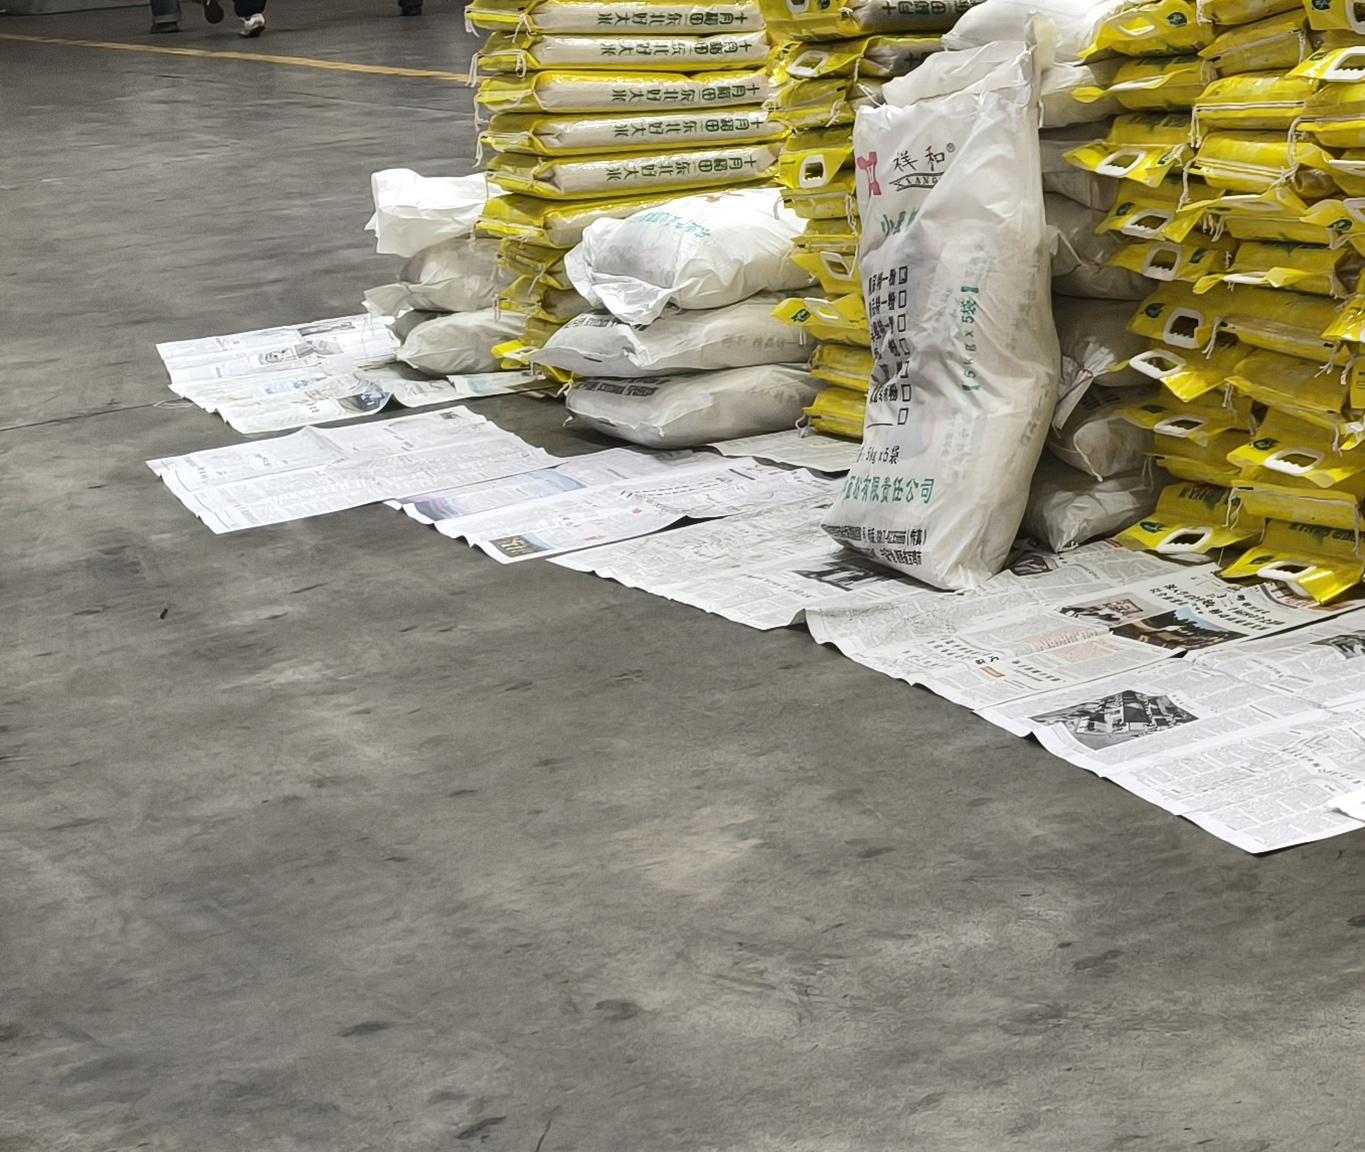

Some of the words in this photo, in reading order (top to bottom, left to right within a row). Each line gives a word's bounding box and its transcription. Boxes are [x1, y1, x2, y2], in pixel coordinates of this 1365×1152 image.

[597, 12, 682, 26] 东北好大米
[689, 12, 747, 26] 十月稻田
[600, 43, 686, 57] 东北好大米
[694, 41, 751, 55] 十月稻田
[611, 89, 695, 102] 东北好大米
[701, 85, 760, 101] 十月稻田
[614, 120, 697, 137] 东北好大米
[704, 118, 763, 133] 十月稻田
[698, 157, 756, 173] 十月稻田
[893, 145, 945, 173] 祥和
[607, 161, 690, 181] 东北好大米
